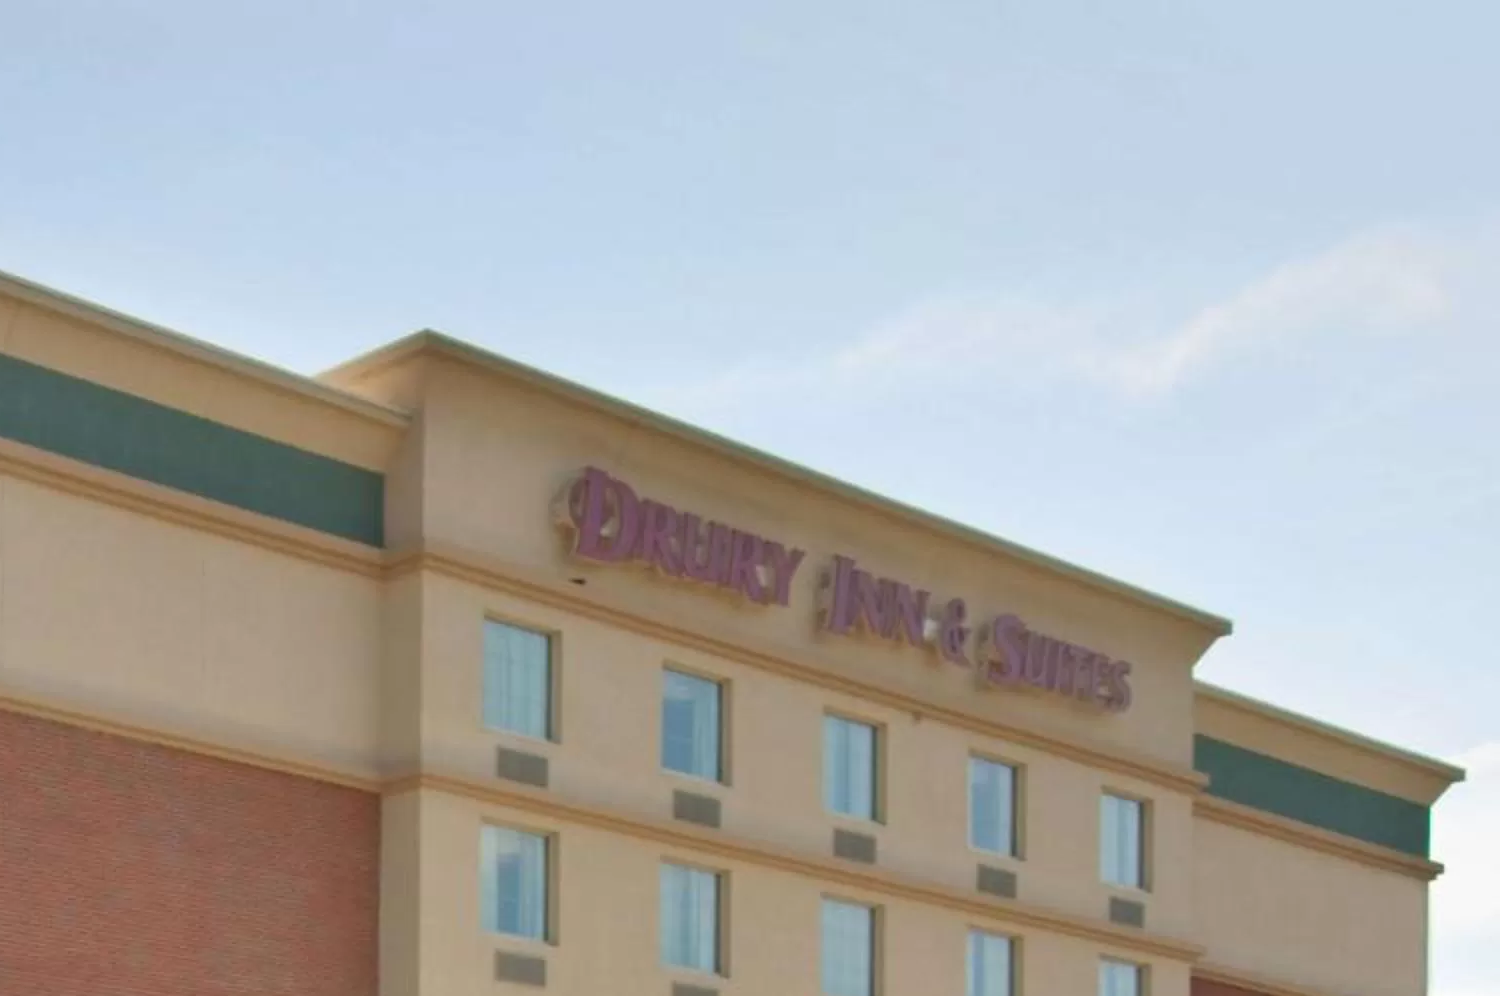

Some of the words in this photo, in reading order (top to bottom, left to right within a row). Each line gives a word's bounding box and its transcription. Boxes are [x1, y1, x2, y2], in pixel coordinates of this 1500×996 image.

[568, 465, 806, 608] DRURY
[828, 554, 931, 646] INN
[940, 598, 971, 668] &
[987, 613, 1133, 713] SUITES
